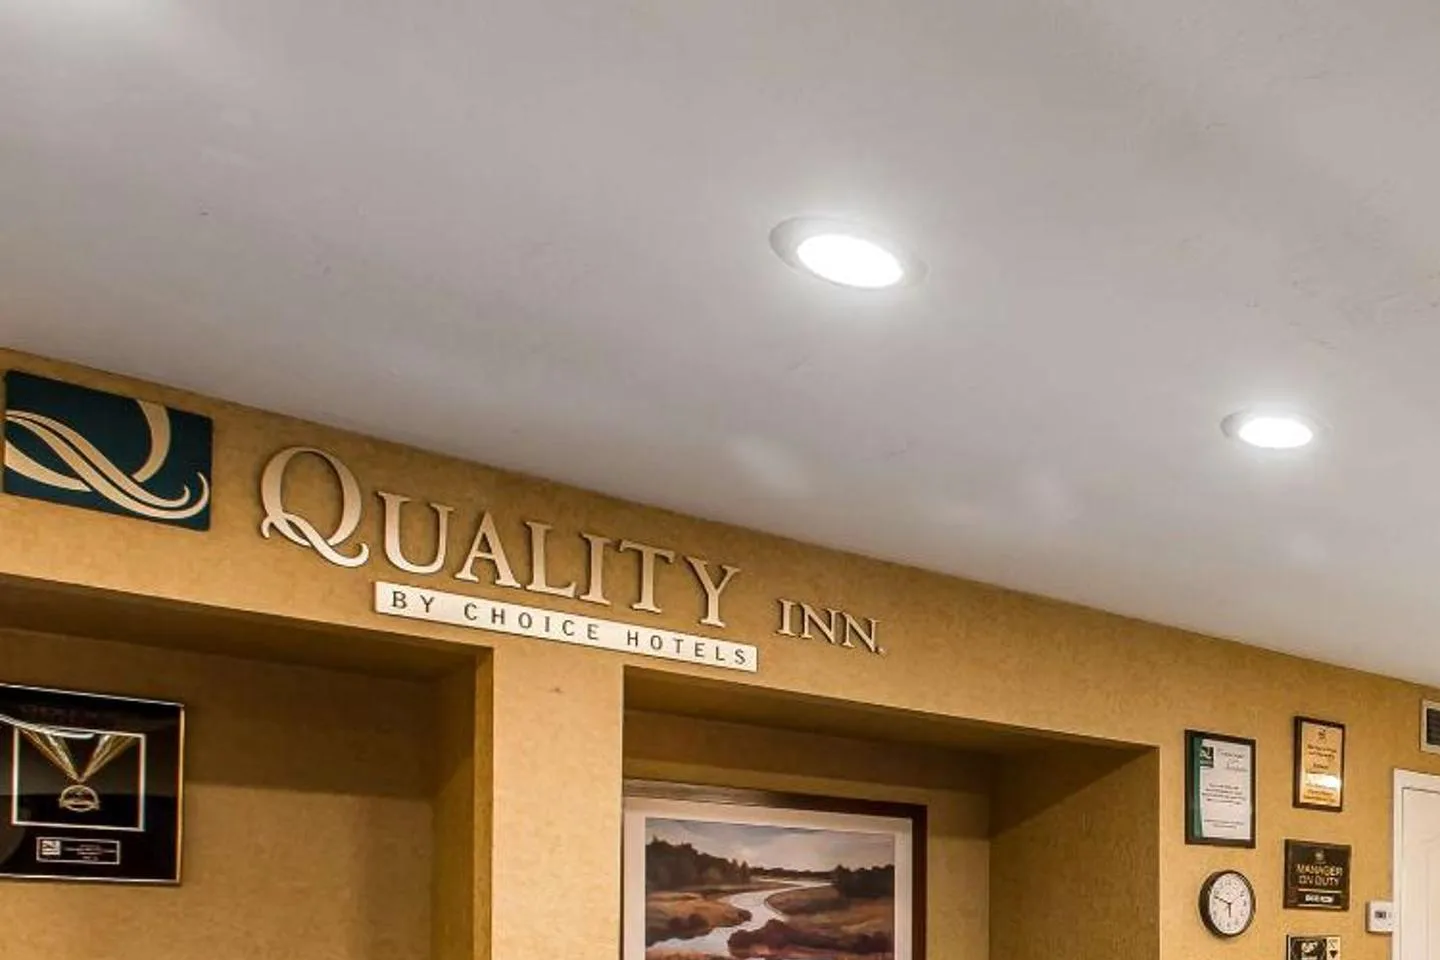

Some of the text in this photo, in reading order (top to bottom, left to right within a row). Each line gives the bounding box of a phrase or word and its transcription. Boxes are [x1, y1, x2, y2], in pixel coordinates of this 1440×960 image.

[259, 446, 741, 629] QUALITY
[391, 590, 748, 666] BY CHOICE HOTELS
